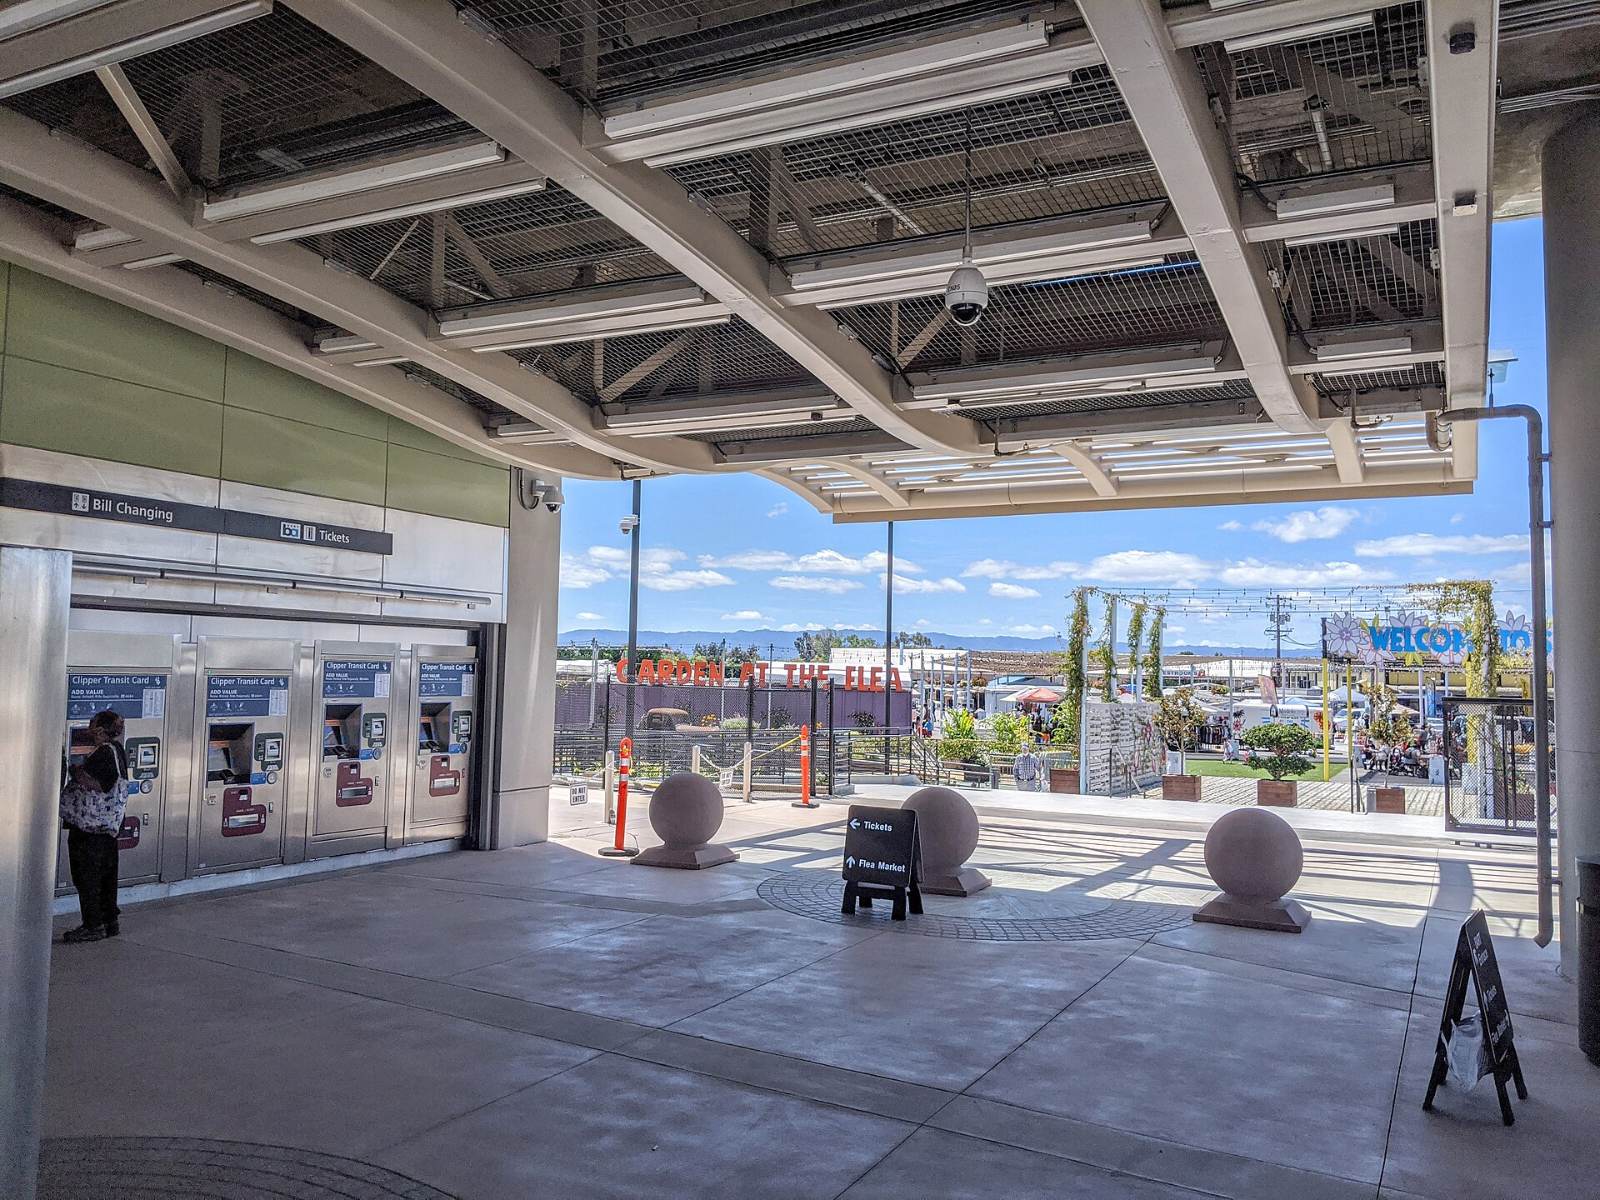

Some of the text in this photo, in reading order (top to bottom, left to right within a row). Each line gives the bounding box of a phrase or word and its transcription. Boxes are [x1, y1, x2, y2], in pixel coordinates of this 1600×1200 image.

[93, 498, 173, 522] Bill Changing
[320, 530, 350, 543] Tickets
[1369, 626, 1473, 653] WELCOM
[326, 662, 346, 670] Clipper
[72, 676, 149, 686] Clipper Transit Card
[211, 677, 235, 686] Clipper
[739, 662, 768, 688] AT
[784, 664, 830, 689] THE
[845, 666, 902, 692] FLEA
[864, 821, 892, 831] Tickets
[859, 859, 905, 872] Flea Market
